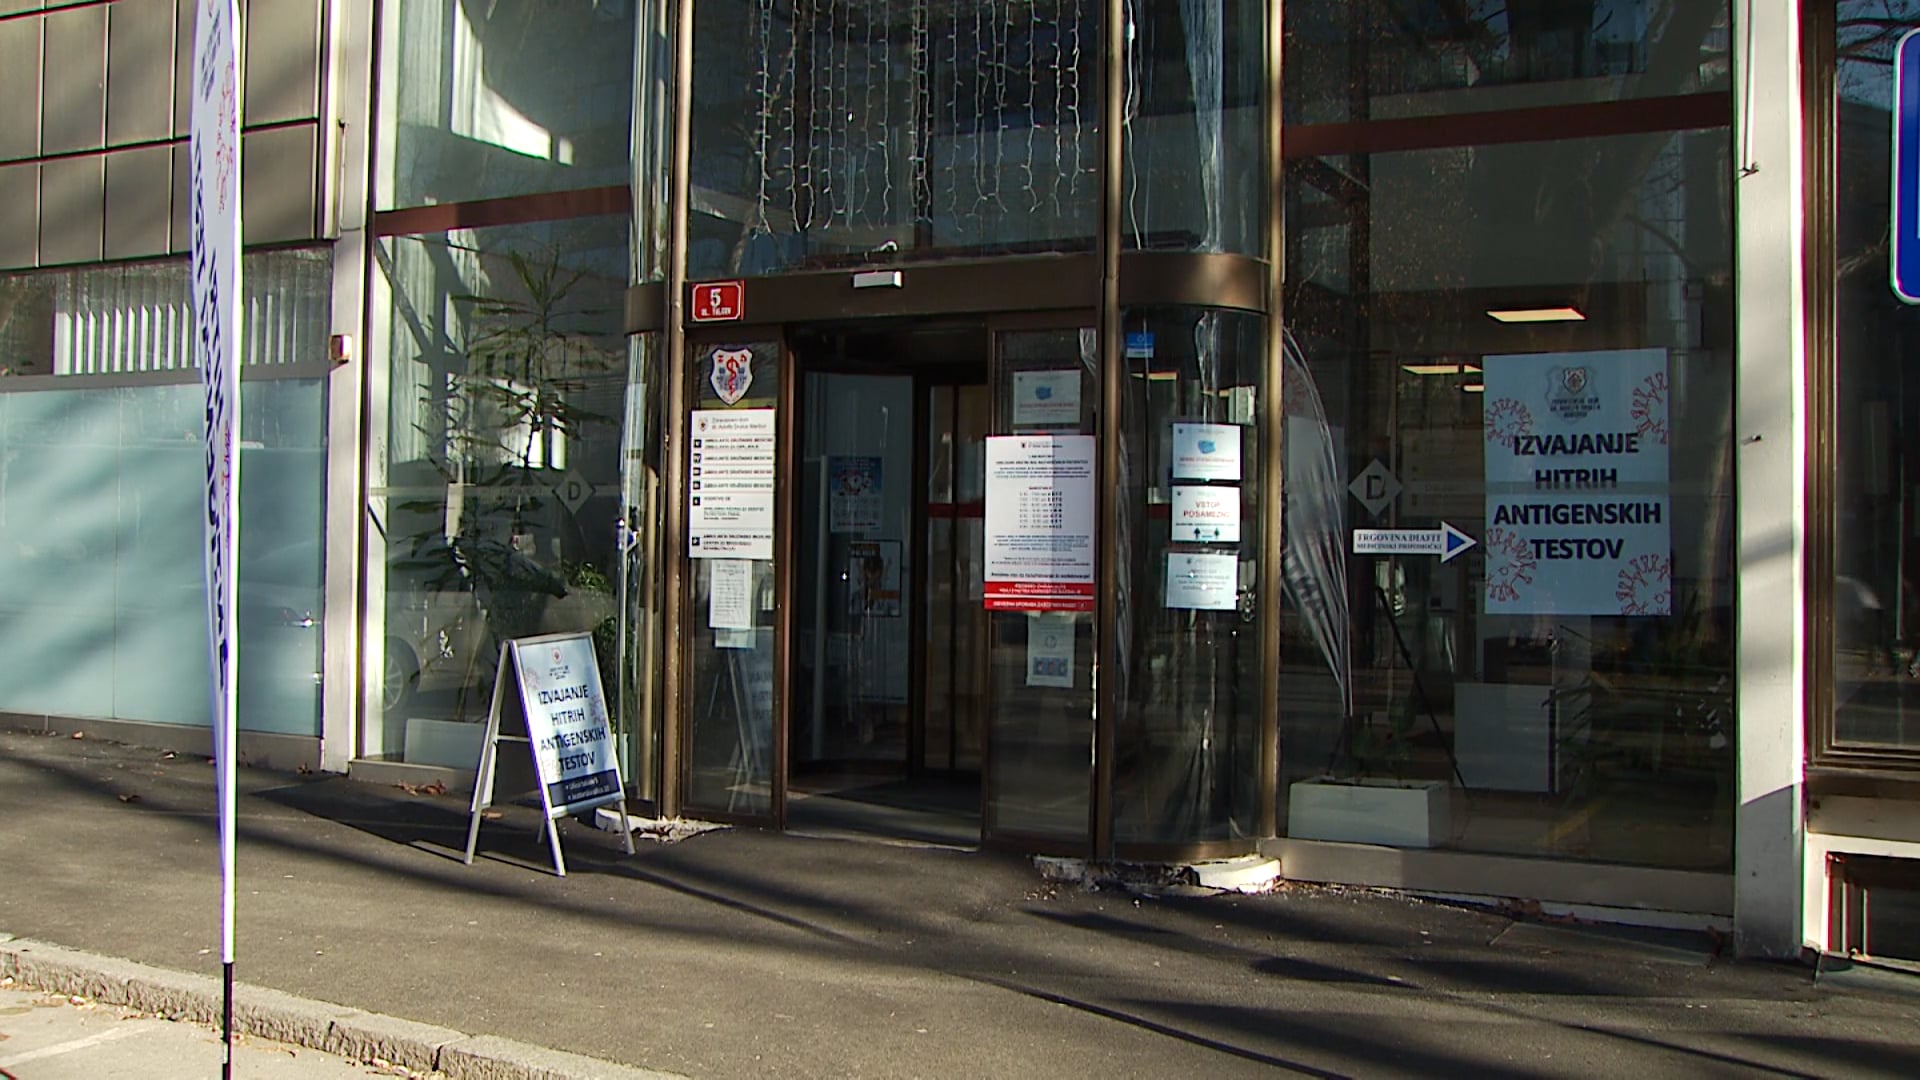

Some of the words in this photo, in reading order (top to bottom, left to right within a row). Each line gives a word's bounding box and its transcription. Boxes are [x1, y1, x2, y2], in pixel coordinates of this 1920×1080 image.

[710, 288, 722, 308] 5
[1513, 433, 1639, 456] IZVAJANJE
[1366, 475, 1385, 500] D
[1534, 469, 1618, 490] HITRIH
[1493, 503, 1662, 525] ANTIGENSKIH
[1530, 538, 1624, 560] TESTOV
[538, 684, 589, 705] IZVAJANJE
[551, 707, 585, 727] HITRIH
[540, 725, 607, 751] ANTIGENSKIH
[559, 751, 596, 772] TESTOV
